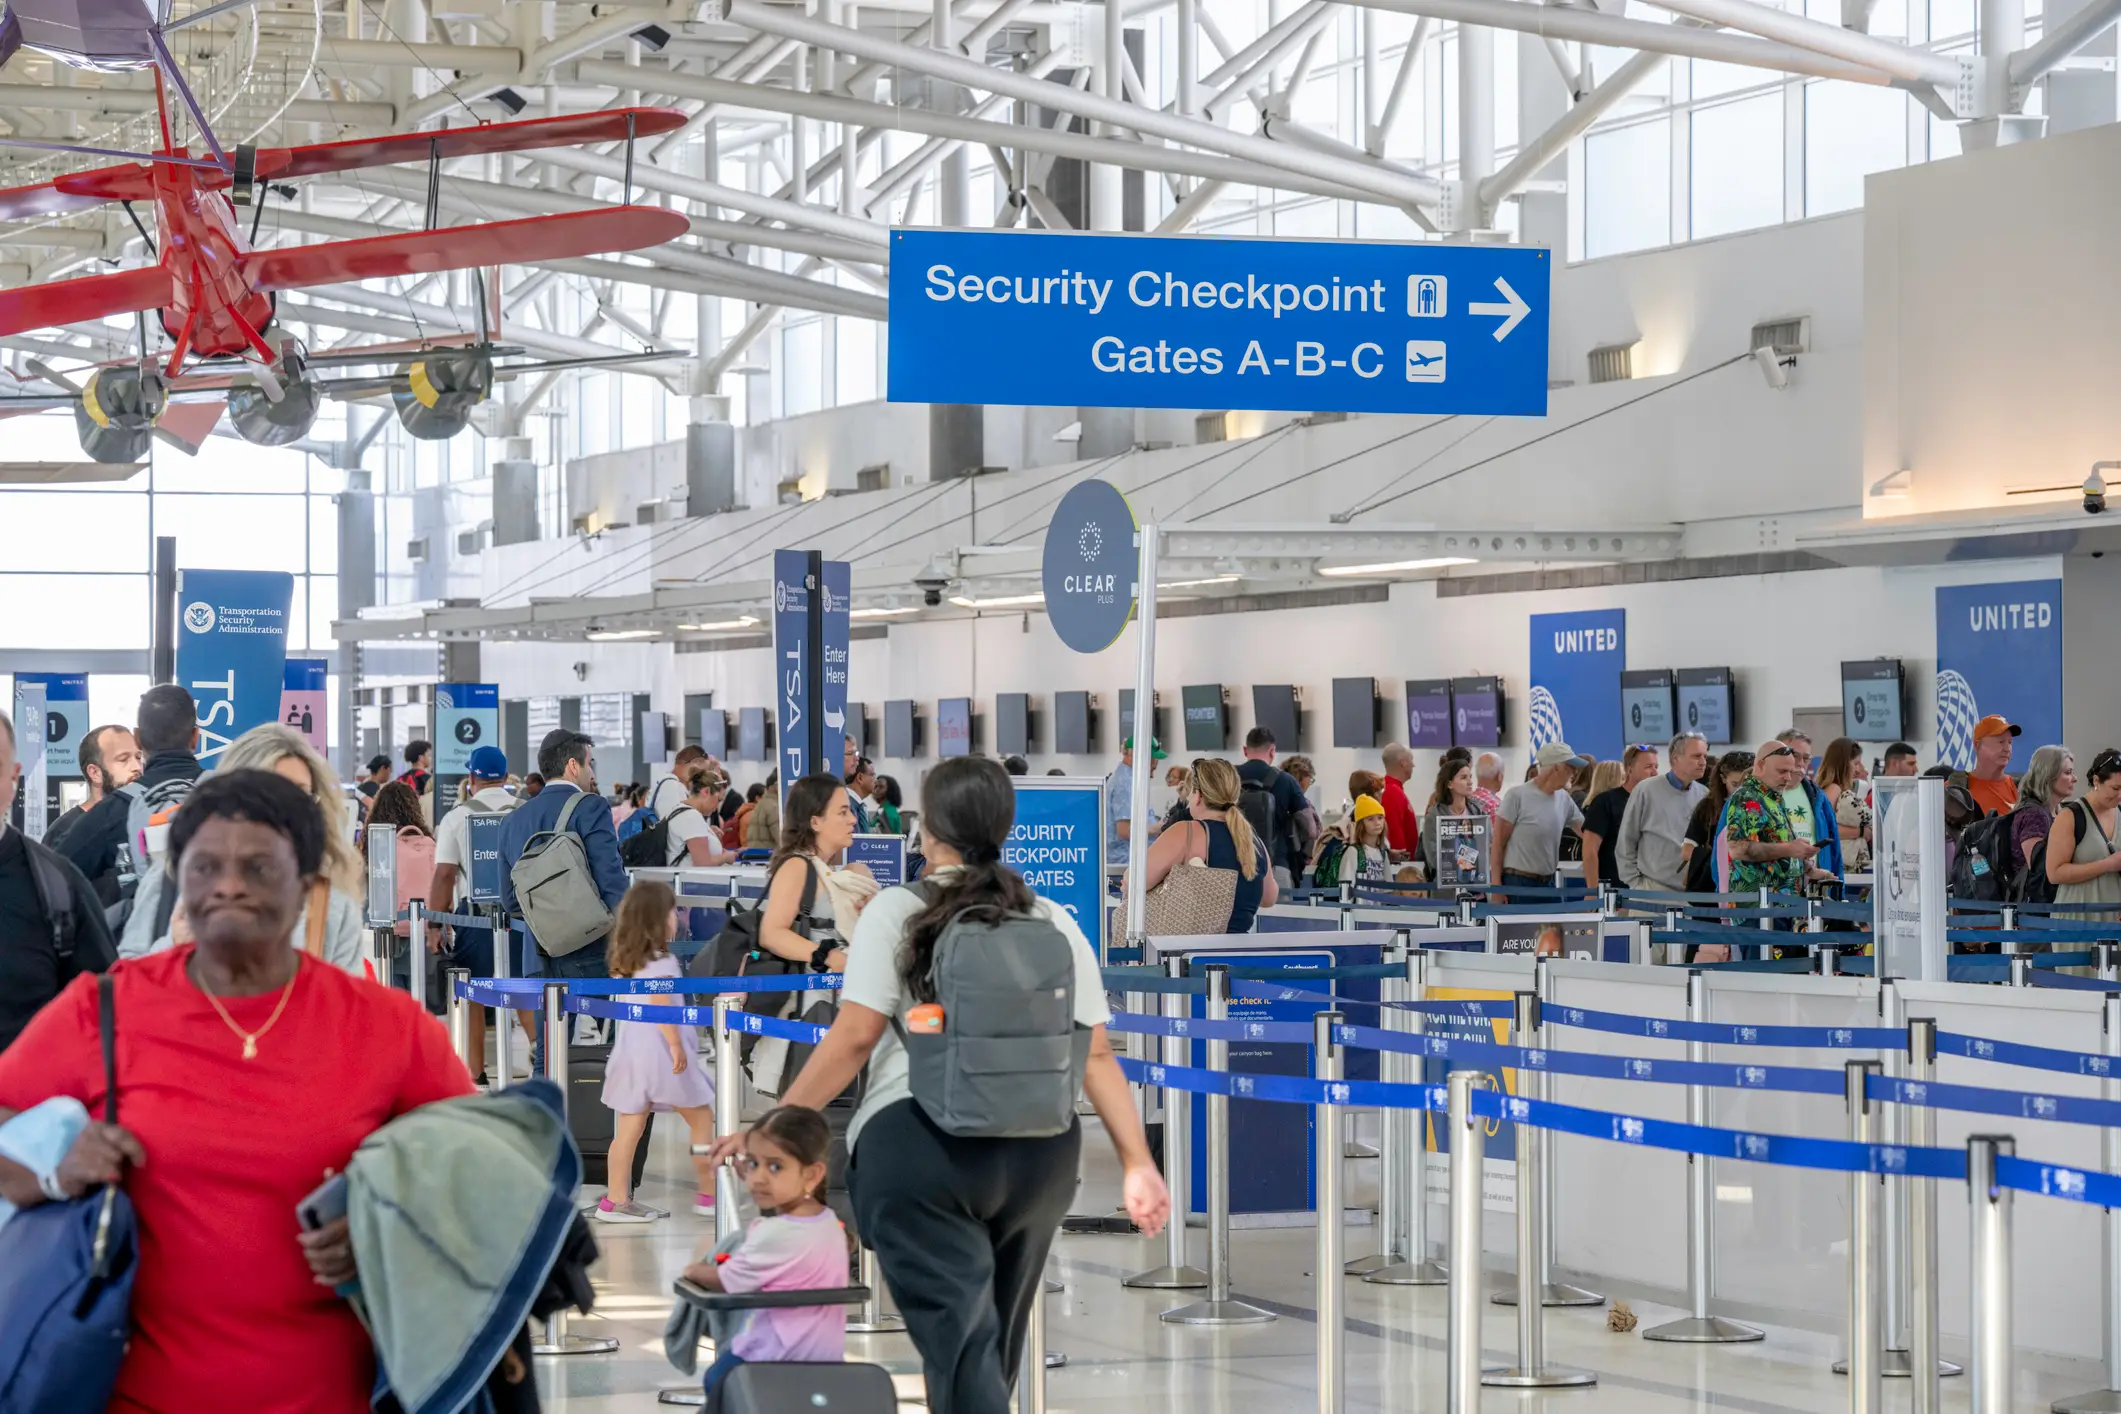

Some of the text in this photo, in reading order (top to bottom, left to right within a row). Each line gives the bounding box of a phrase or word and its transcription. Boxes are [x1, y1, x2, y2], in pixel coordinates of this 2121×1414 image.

[925, 264, 1386, 318] Security Checkpoint
[1091, 335, 1385, 378] Gates A-B-C
[1064, 574, 1115, 593] CLEAR
[1097, 595, 1114, 604] PLUS
[218, 606, 282, 617] Transportation
[1970, 602, 2051, 632] UNITED
[218, 615, 255, 626] Security
[218, 624, 283, 634] Administration
[1555, 628, 1617, 654] UNITED
[825, 645, 847, 663] Enter
[826, 665, 845, 684] Here
[787, 639, 801, 732] TSA
[192, 669, 235, 760] TSA
[49, 719, 56, 735] 1
[463, 724, 474, 739] 2
[473, 819, 485, 827] TSA
[1005, 824, 1075, 841] ECURITY
[1000, 847, 1088, 864] ECKPOINT
[1023, 870, 1075, 887] GATES
[1502, 938, 1537, 950] ARE YOU
[1239, 996, 1263, 1005] check
